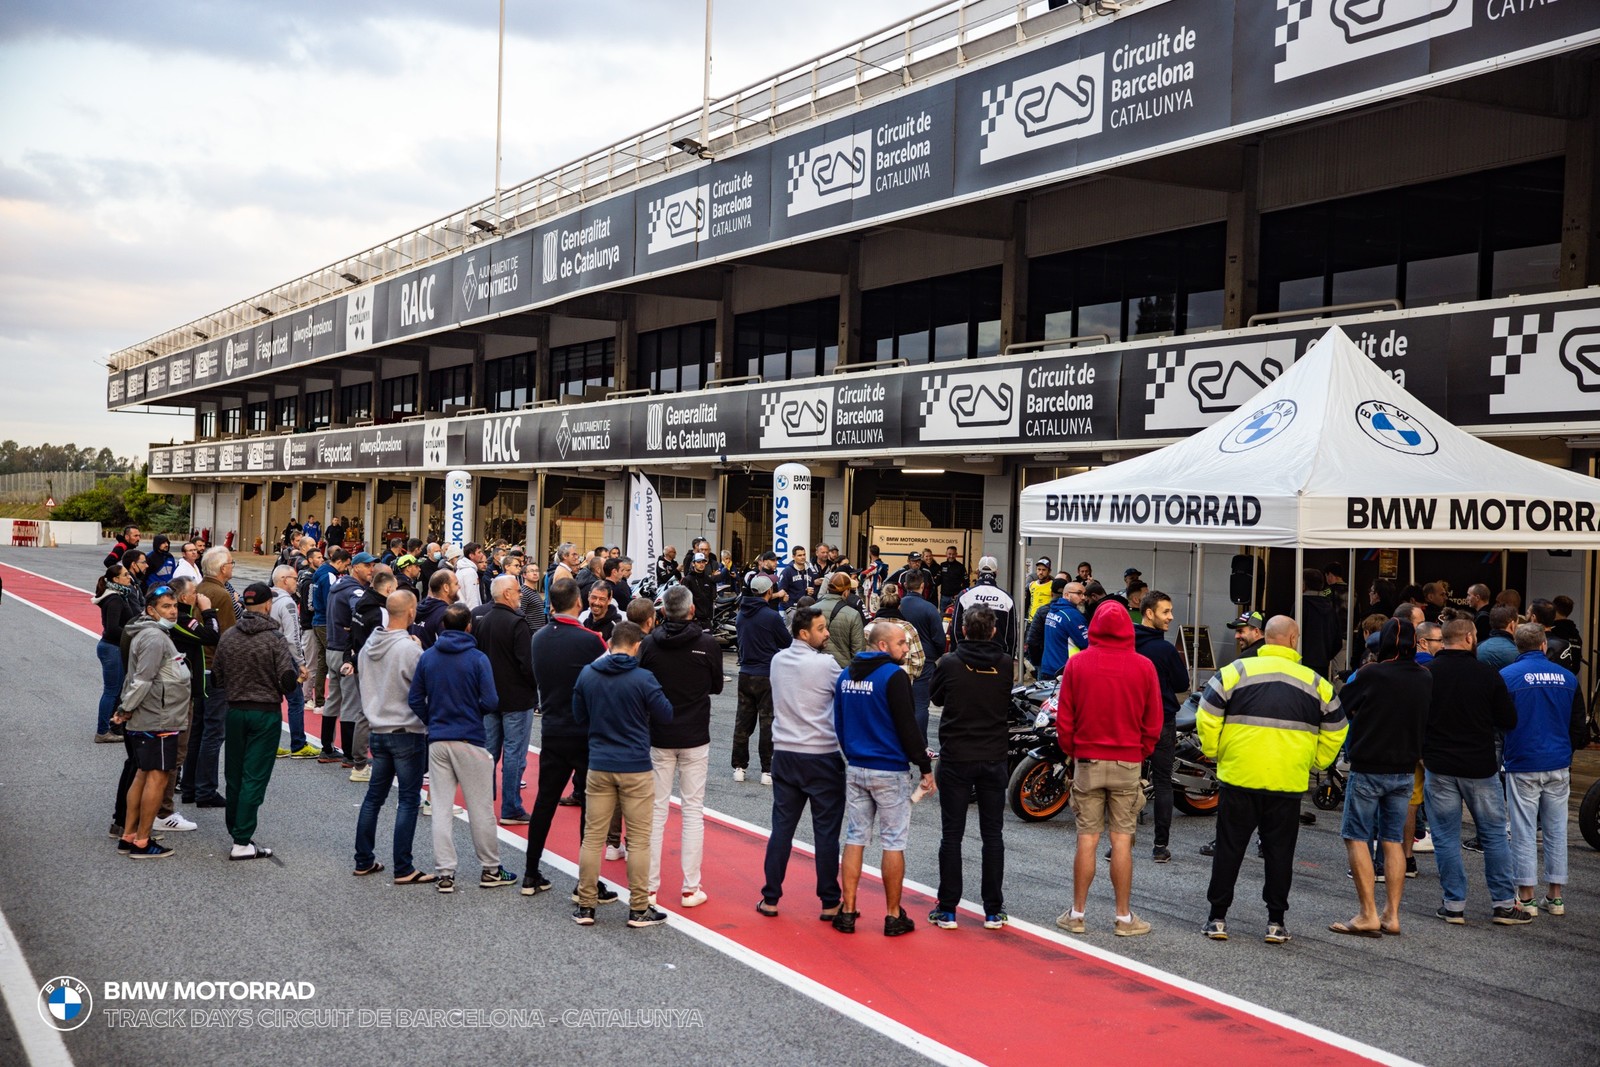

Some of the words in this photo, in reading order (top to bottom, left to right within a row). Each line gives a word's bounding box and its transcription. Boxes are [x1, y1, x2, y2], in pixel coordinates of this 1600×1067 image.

[1112, 32, 1171, 73] Circuit
[1173, 25, 1197, 53] de
[1111, 61, 1195, 102] Barcelona
[1110, 88, 1194, 129] CATALUNYA
[876, 115, 915, 147] Circuit
[917, 111, 932, 133] de
[875, 139, 931, 171] Barcelona
[712, 173, 740, 198] Circuit
[741, 171, 753, 188] de
[875, 162, 931, 193] CATALUNYA
[712, 193, 752, 219] Barcelona
[561, 216, 611, 252] Generalitat
[711, 215, 752, 237] CATALUNYA
[479, 257, 510, 277] AJUNTAMENT
[511, 255, 519, 269] DE
[560, 259, 572, 278] de
[574, 244, 620, 274] Catalunya
[478, 273, 519, 300] MONTMELÓ
[401, 274, 436, 327] RACC
[1380, 329, 1408, 358] de
[1028, 363, 1075, 389] Circuit
[1077, 362, 1096, 385] de
[838, 384, 871, 405] Circuit
[872, 382, 885, 401] de
[1026, 389, 1094, 414] Barcelona
[572, 420, 602, 432] AJUNTAMENT
[602, 419, 611, 431] DE
[666, 403, 717, 426] Generalitat
[837, 405, 884, 426] Barcelona
[1025, 417, 1093, 437] CATALUNYA
[482, 416, 521, 462] RACC
[571, 432, 611, 451] MONTMELÓ
[665, 432, 677, 450] de
[678, 428, 727, 454] Catalunya
[836, 427, 884, 445] CATALUNYA
[324, 442, 352, 467] esportcat
[831, 514, 839, 526] 39
[1045, 494, 1103, 522] BMW
[1109, 495, 1262, 527] MOTORRAD
[1346, 497, 1437, 530] BMW
[1449, 498, 1600, 532] MOTORR
[992, 517, 1003, 531] 38
[975, 594, 999, 602] tyco
[847, 680, 873, 691] YAMAHA
[1533, 673, 1566, 682] YAMAHA
